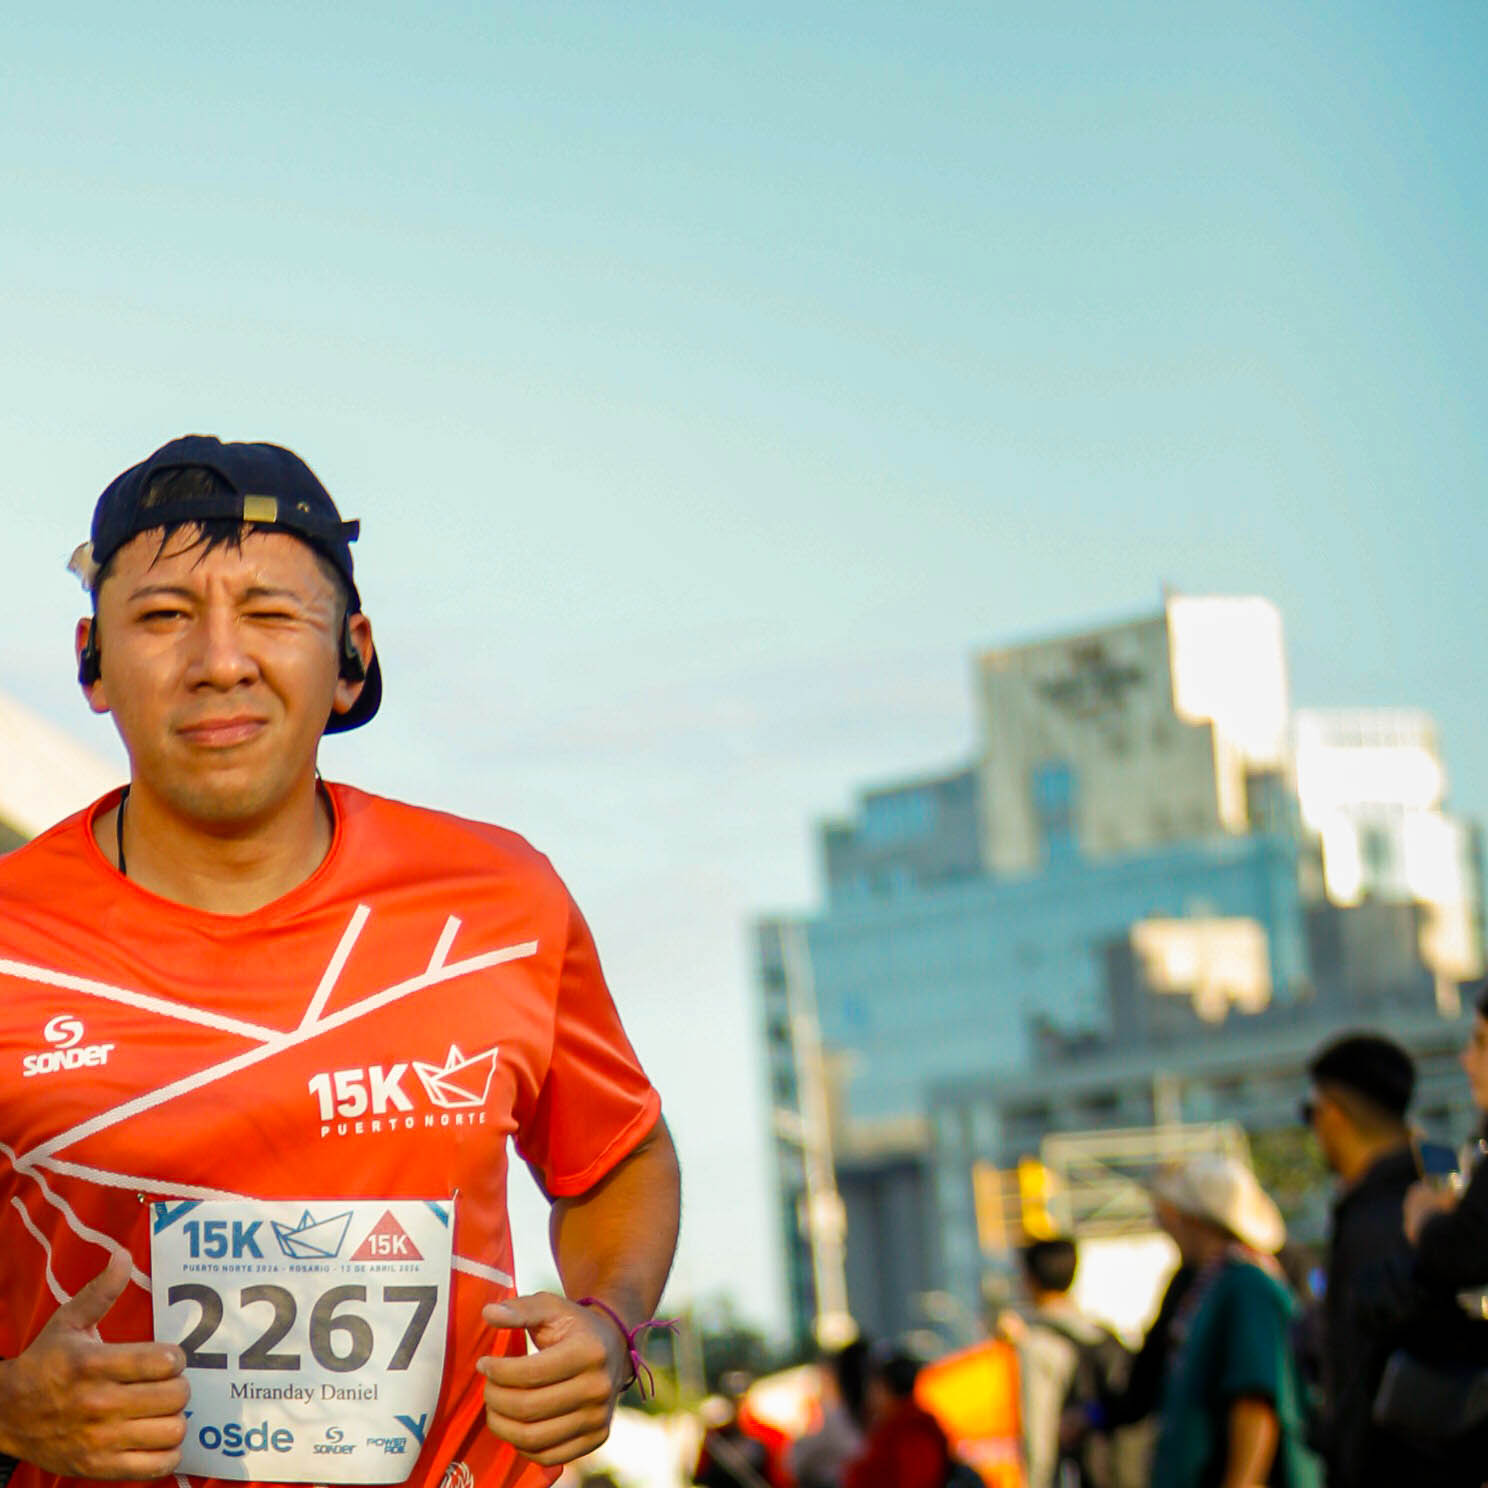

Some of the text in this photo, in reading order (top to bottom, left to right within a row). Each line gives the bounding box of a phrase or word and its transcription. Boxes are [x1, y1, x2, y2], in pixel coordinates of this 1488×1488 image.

[308, 1063, 414, 1121] 15K
[320, 1111, 487, 1139] PUERTO NORTE
[183, 1220, 264, 1259] 15K
[367, 1233, 408, 1256] 15K
[183, 1263, 220, 1273] PUERTO
[167, 1283, 439, 1373] 2267
[230, 1382, 379, 1404] Miranday Daniel
[199, 1420, 294, 1457] osde
